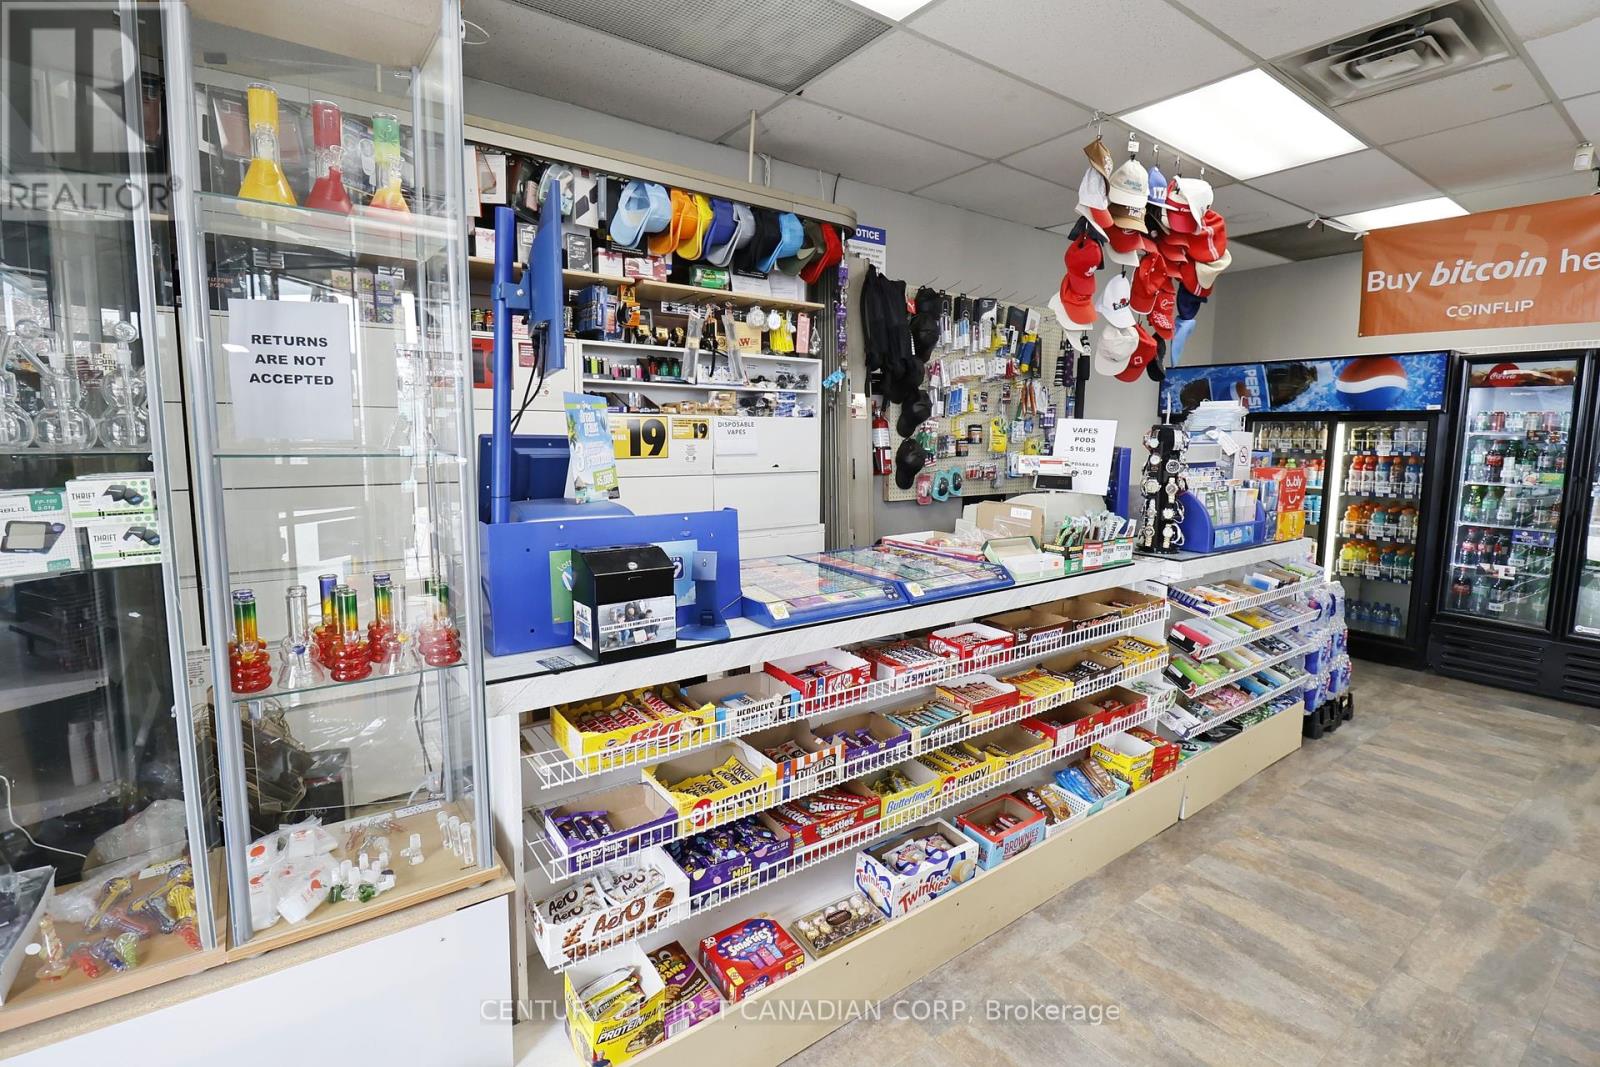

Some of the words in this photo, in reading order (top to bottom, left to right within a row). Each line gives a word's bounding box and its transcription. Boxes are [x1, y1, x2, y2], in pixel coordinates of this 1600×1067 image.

[856, 228, 880, 241] OTICE
[1367, 270, 1423, 293] Buy
[1430, 251, 1547, 287] bitcoin
[1446, 300, 1534, 318] COINFLIP
[251, 334, 328, 348] RETURNS
[255, 354, 288, 365] ARE
[293, 356, 326, 367] NOT
[249, 373, 334, 386] ACCEPTED
[1245, 368, 1262, 409] PEPSI
[626, 418, 666, 457] 19
[692, 423, 708, 439] 19
[71, 492, 96, 501] THRIFT
[93, 533, 117, 543] THRIFT
[796, 756, 835, 778] TURTLES
[716, 781, 768, 813] HENRY!
[886, 785, 934, 814] Butterfinger
[820, 816, 856, 838] Skittles
[576, 849, 602, 863] DAIRY
[603, 841, 623, 853] MILK
[898, 874, 952, 914] Twinkies
[727, 927, 774, 957] Smarties
[597, 1015, 645, 1045] PROTEIN
